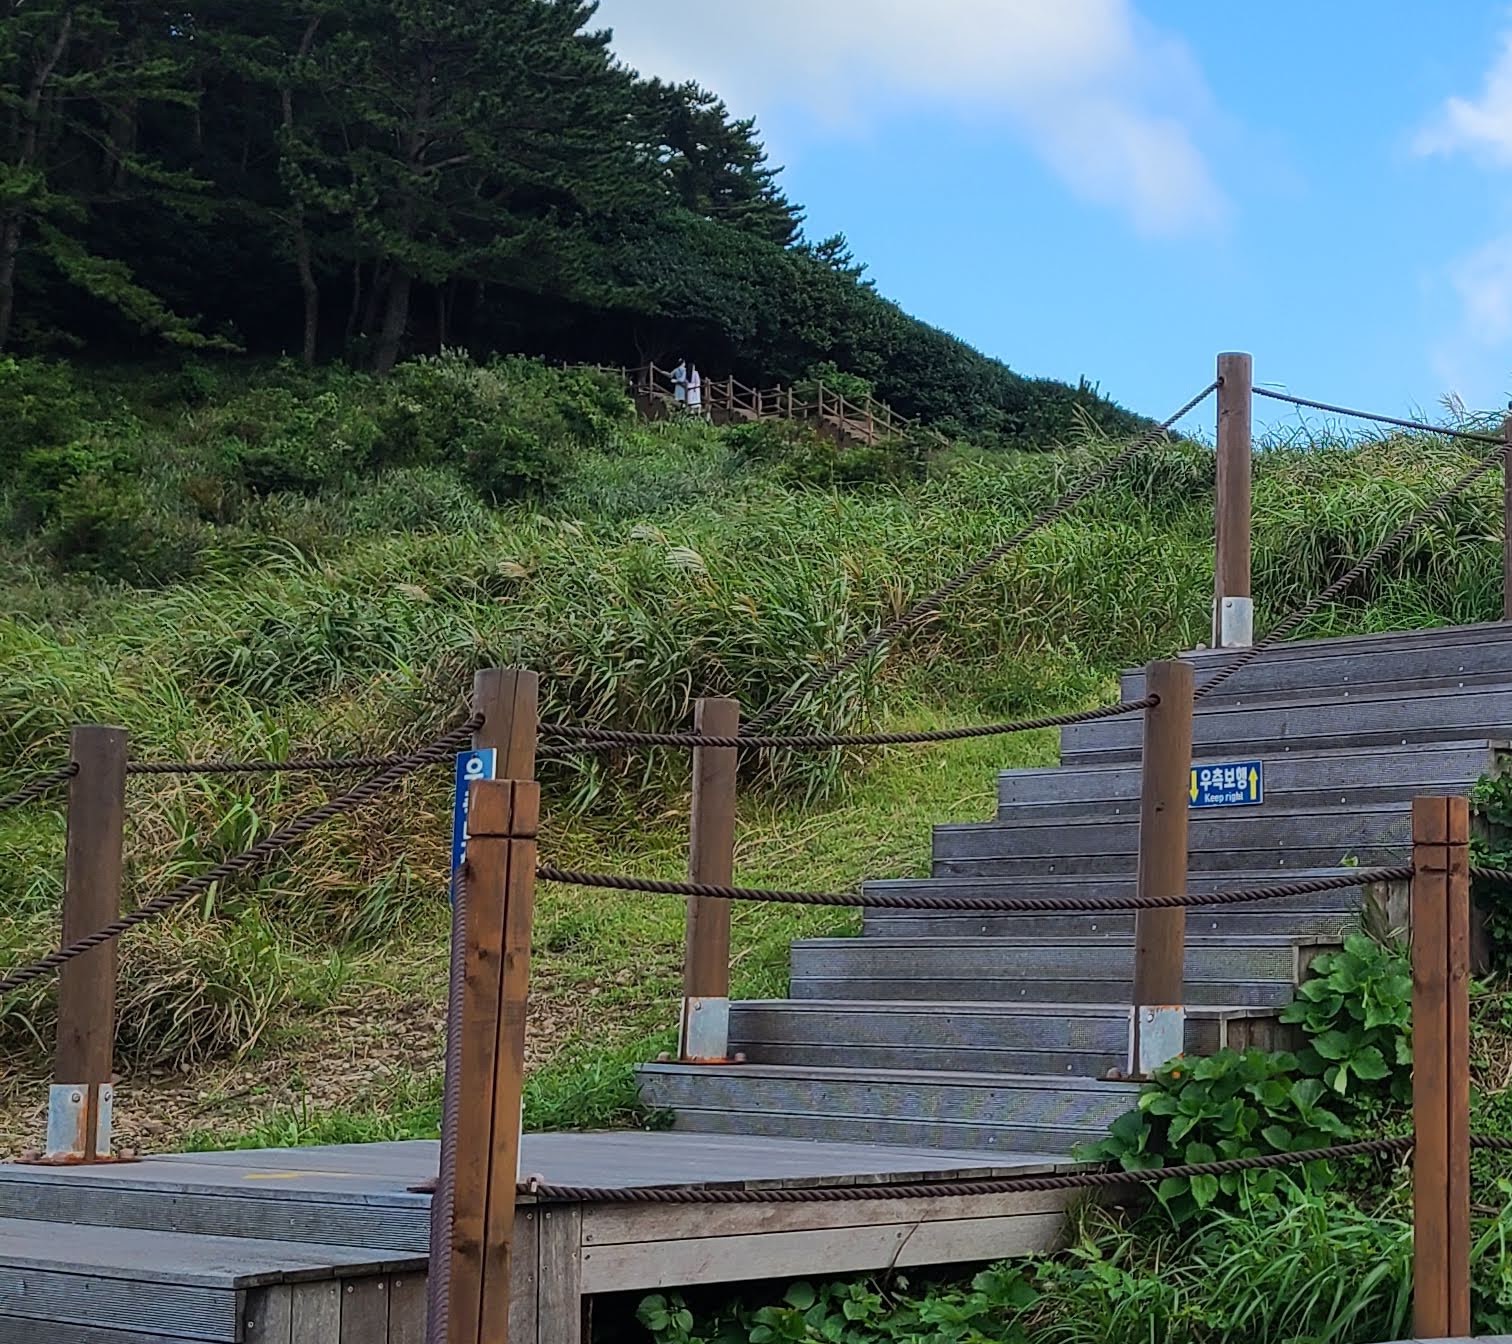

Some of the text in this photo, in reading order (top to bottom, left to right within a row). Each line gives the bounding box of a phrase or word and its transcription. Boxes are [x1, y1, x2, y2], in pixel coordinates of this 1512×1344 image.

[1200, 766, 1247, 791] 우측보행
[1204, 791, 1243, 803] Keep right
